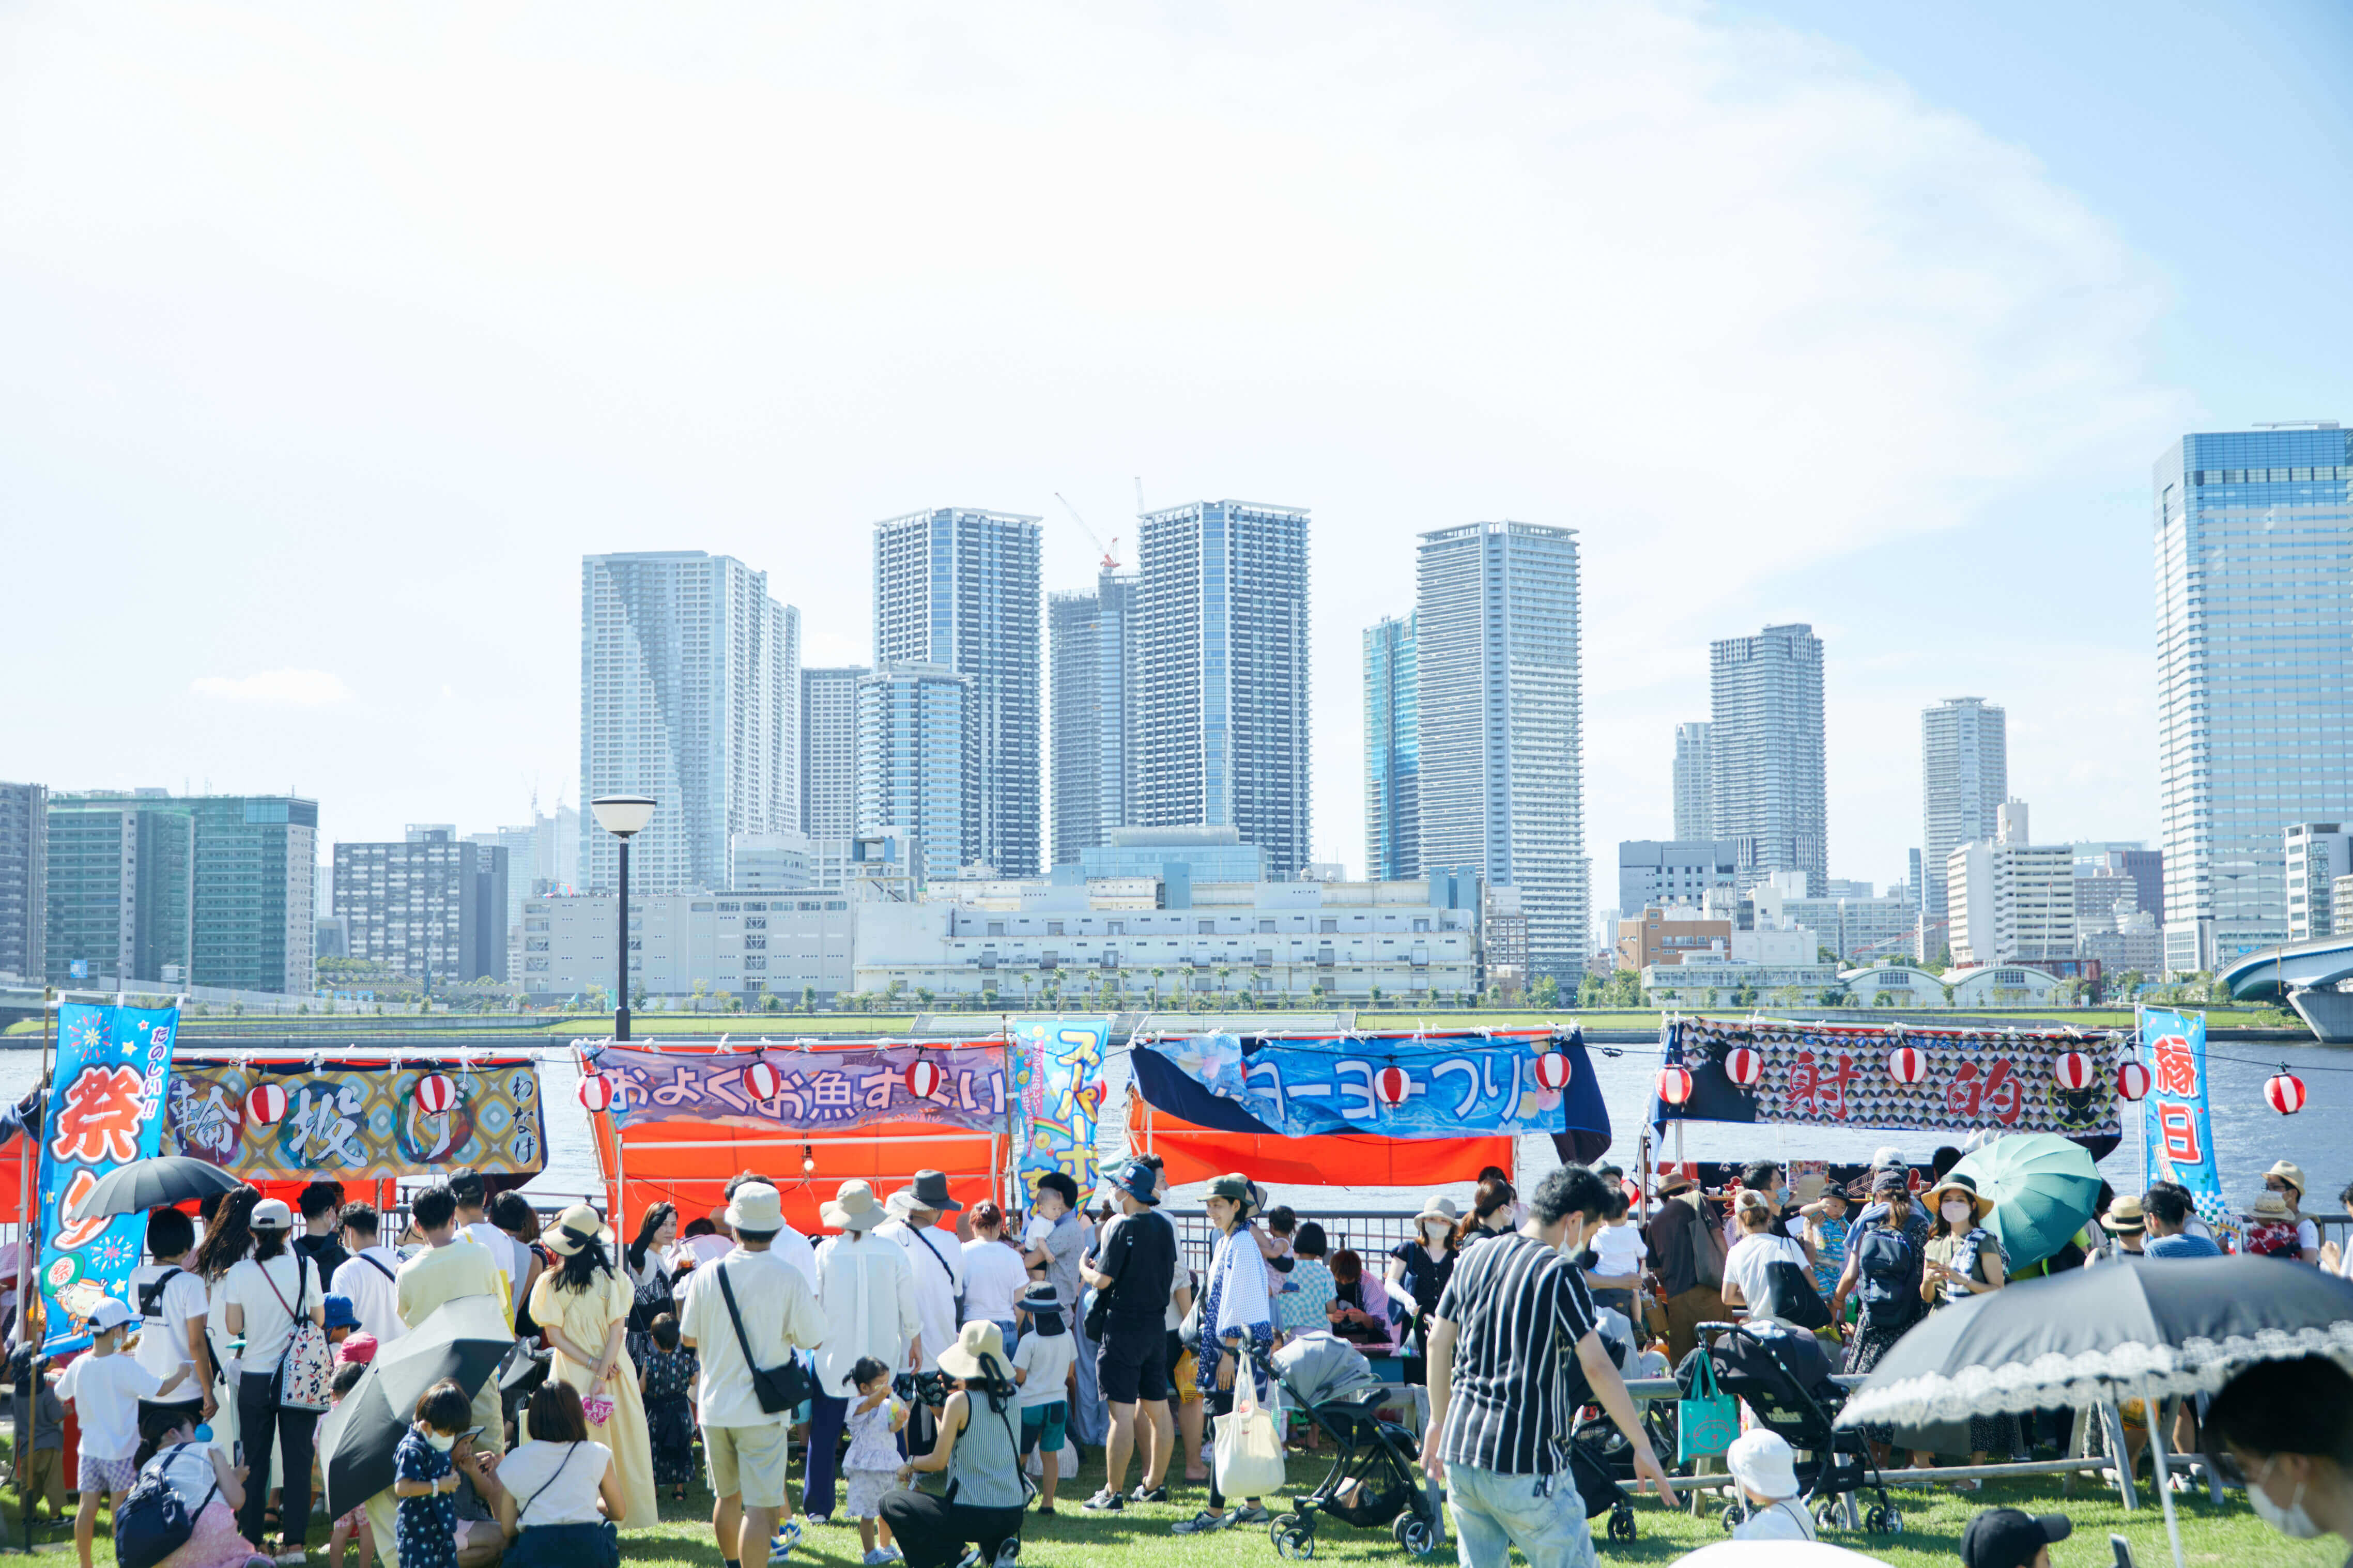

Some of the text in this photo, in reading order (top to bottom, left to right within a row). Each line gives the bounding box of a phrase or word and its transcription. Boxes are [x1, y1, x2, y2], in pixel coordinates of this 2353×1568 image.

[140, 1026, 171, 1120] たのしい!!
[1784, 1050, 2023, 1125] 射的
[2151, 1033, 2203, 1164] 縁日
[168, 1079, 469, 1168] 輪投げ
[512, 1076, 536, 1167] わなげ
[1052, 1027, 1100, 1219] スーパーボー
